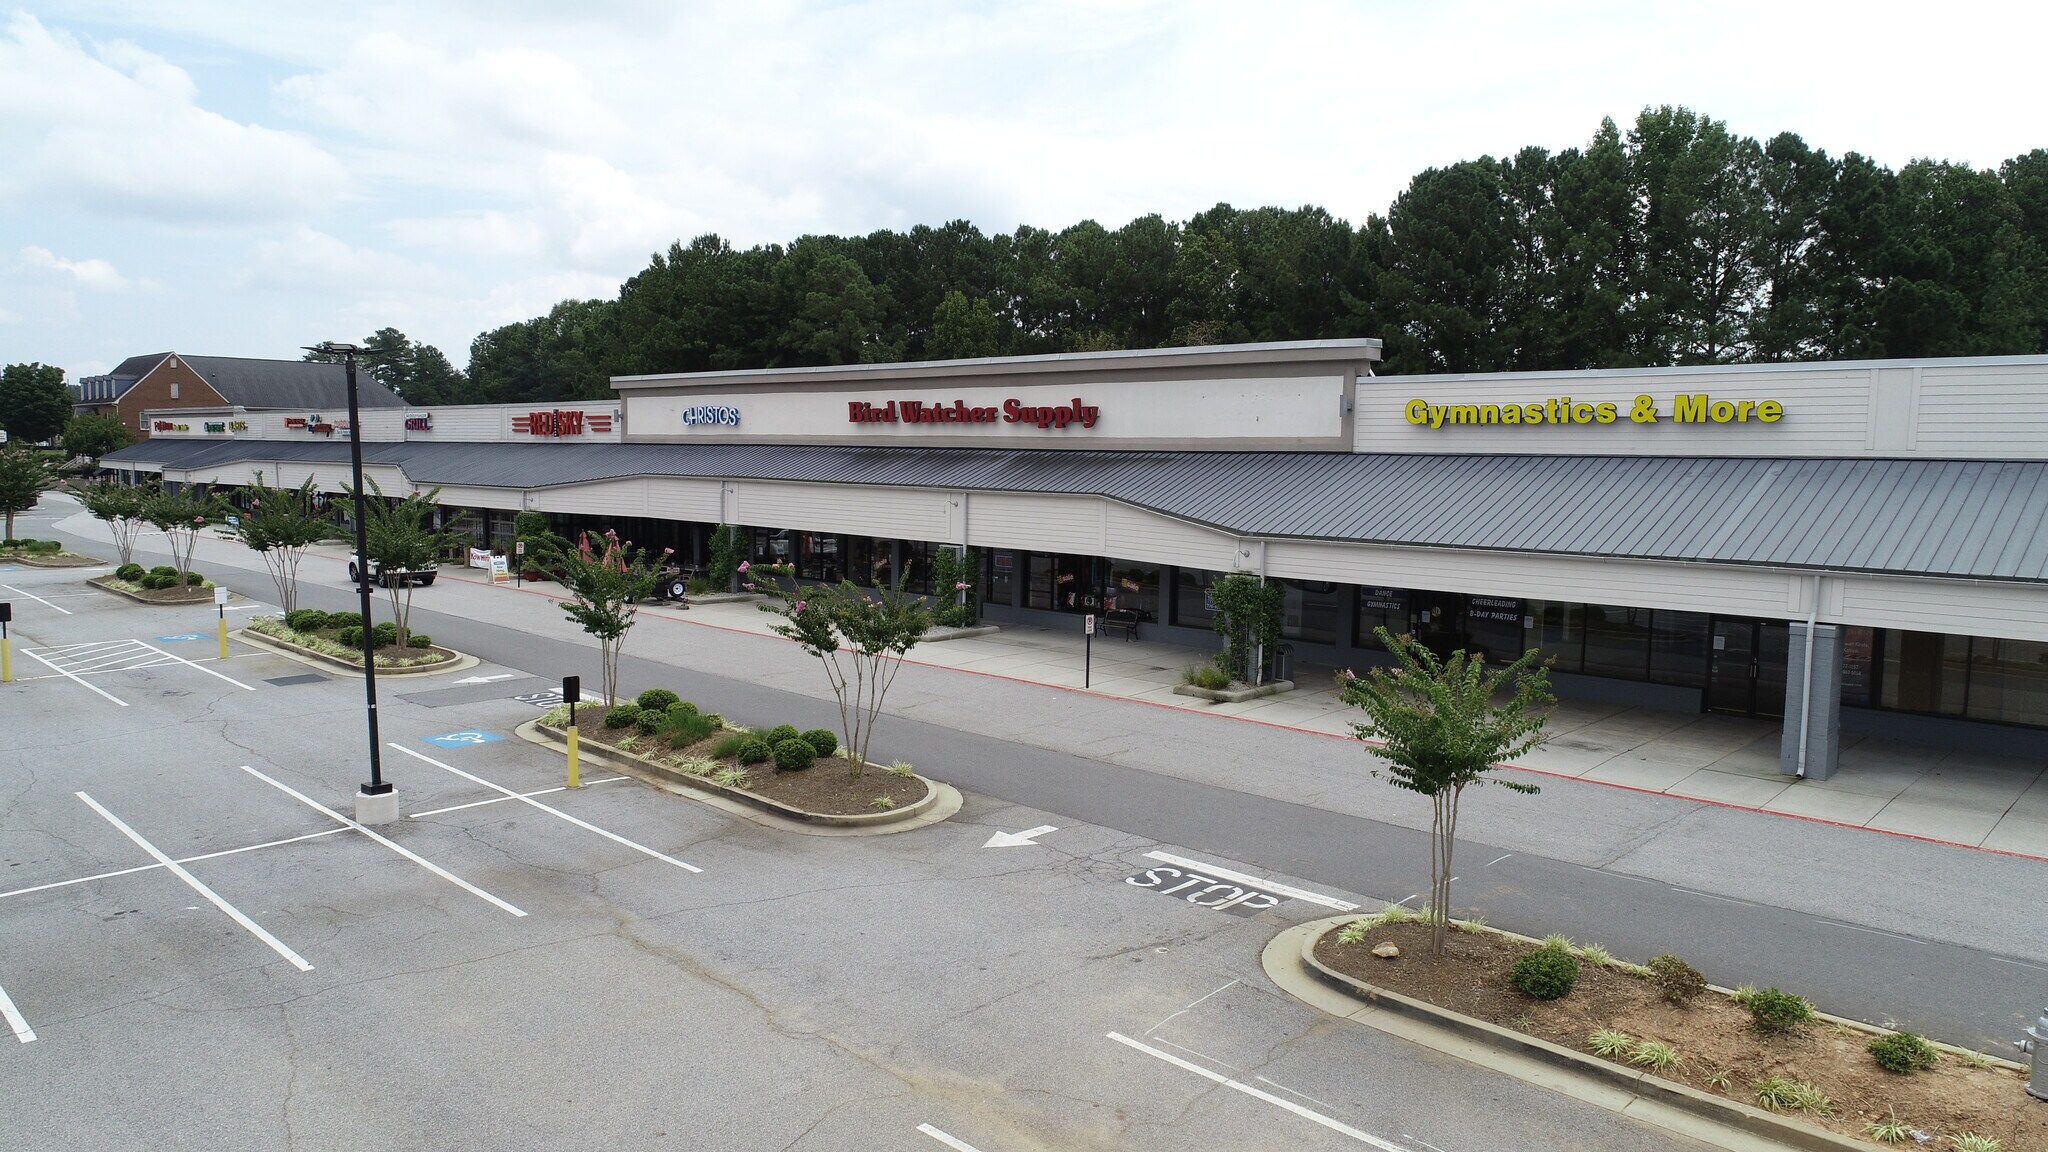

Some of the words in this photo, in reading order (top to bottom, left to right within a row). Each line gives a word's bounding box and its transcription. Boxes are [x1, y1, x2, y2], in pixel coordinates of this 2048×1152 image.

[682, 406, 740, 427] CHRISTOS
[848, 401, 898, 424] Bird
[899, 400, 999, 424] Watcher
[1003, 398, 1099, 429] Supply
[1404, 397, 1618, 429] Gymnastics
[1629, 394, 1658, 424] &
[1672, 394, 1784, 424] More
[529, 411, 554, 436] RED
[557, 410, 584, 435] SKY
[1374, 589, 1393, 598] DANCE
[1471, 598, 1517, 609] CHEERLEADING
[1367, 600, 1401, 610] GYMNASTICS
[1491, 612, 1518, 621] PARTIES
[1124, 866, 1279, 911] STOP
